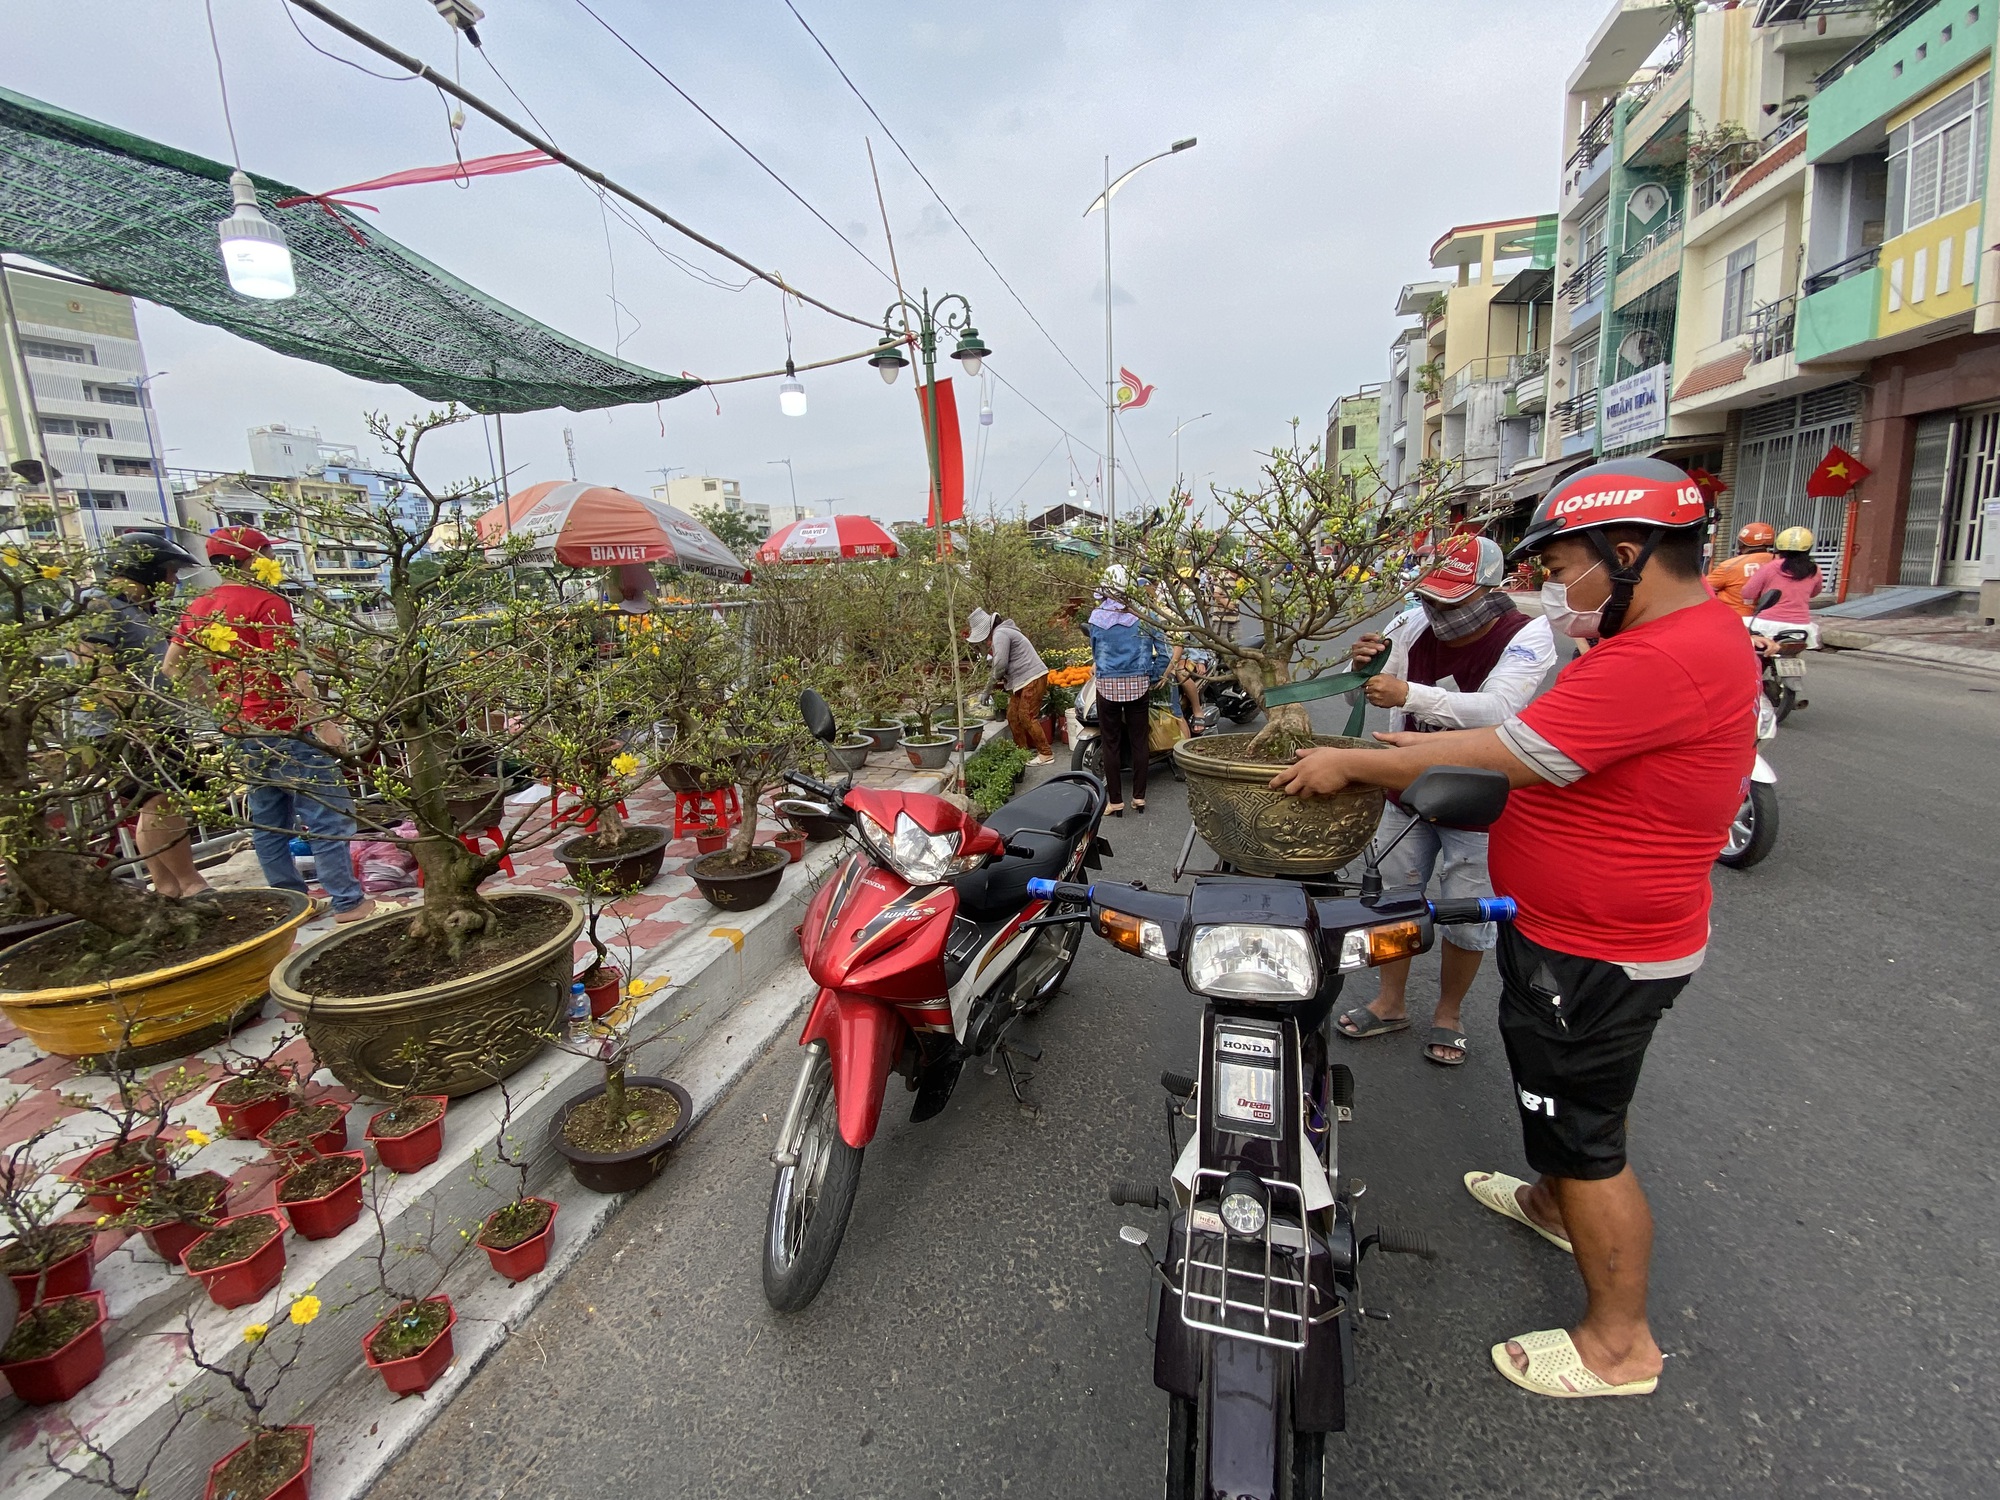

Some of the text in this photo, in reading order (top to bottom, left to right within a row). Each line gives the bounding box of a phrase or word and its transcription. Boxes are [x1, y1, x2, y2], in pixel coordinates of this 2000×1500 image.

[1554, 489, 1651, 516] LOSHIP
[590, 546, 647, 562] BIA VIỆT
[860, 878, 886, 891] HONDA
[1223, 1040, 1272, 1054] HONDA
[1237, 1098, 1271, 1110] Dream
